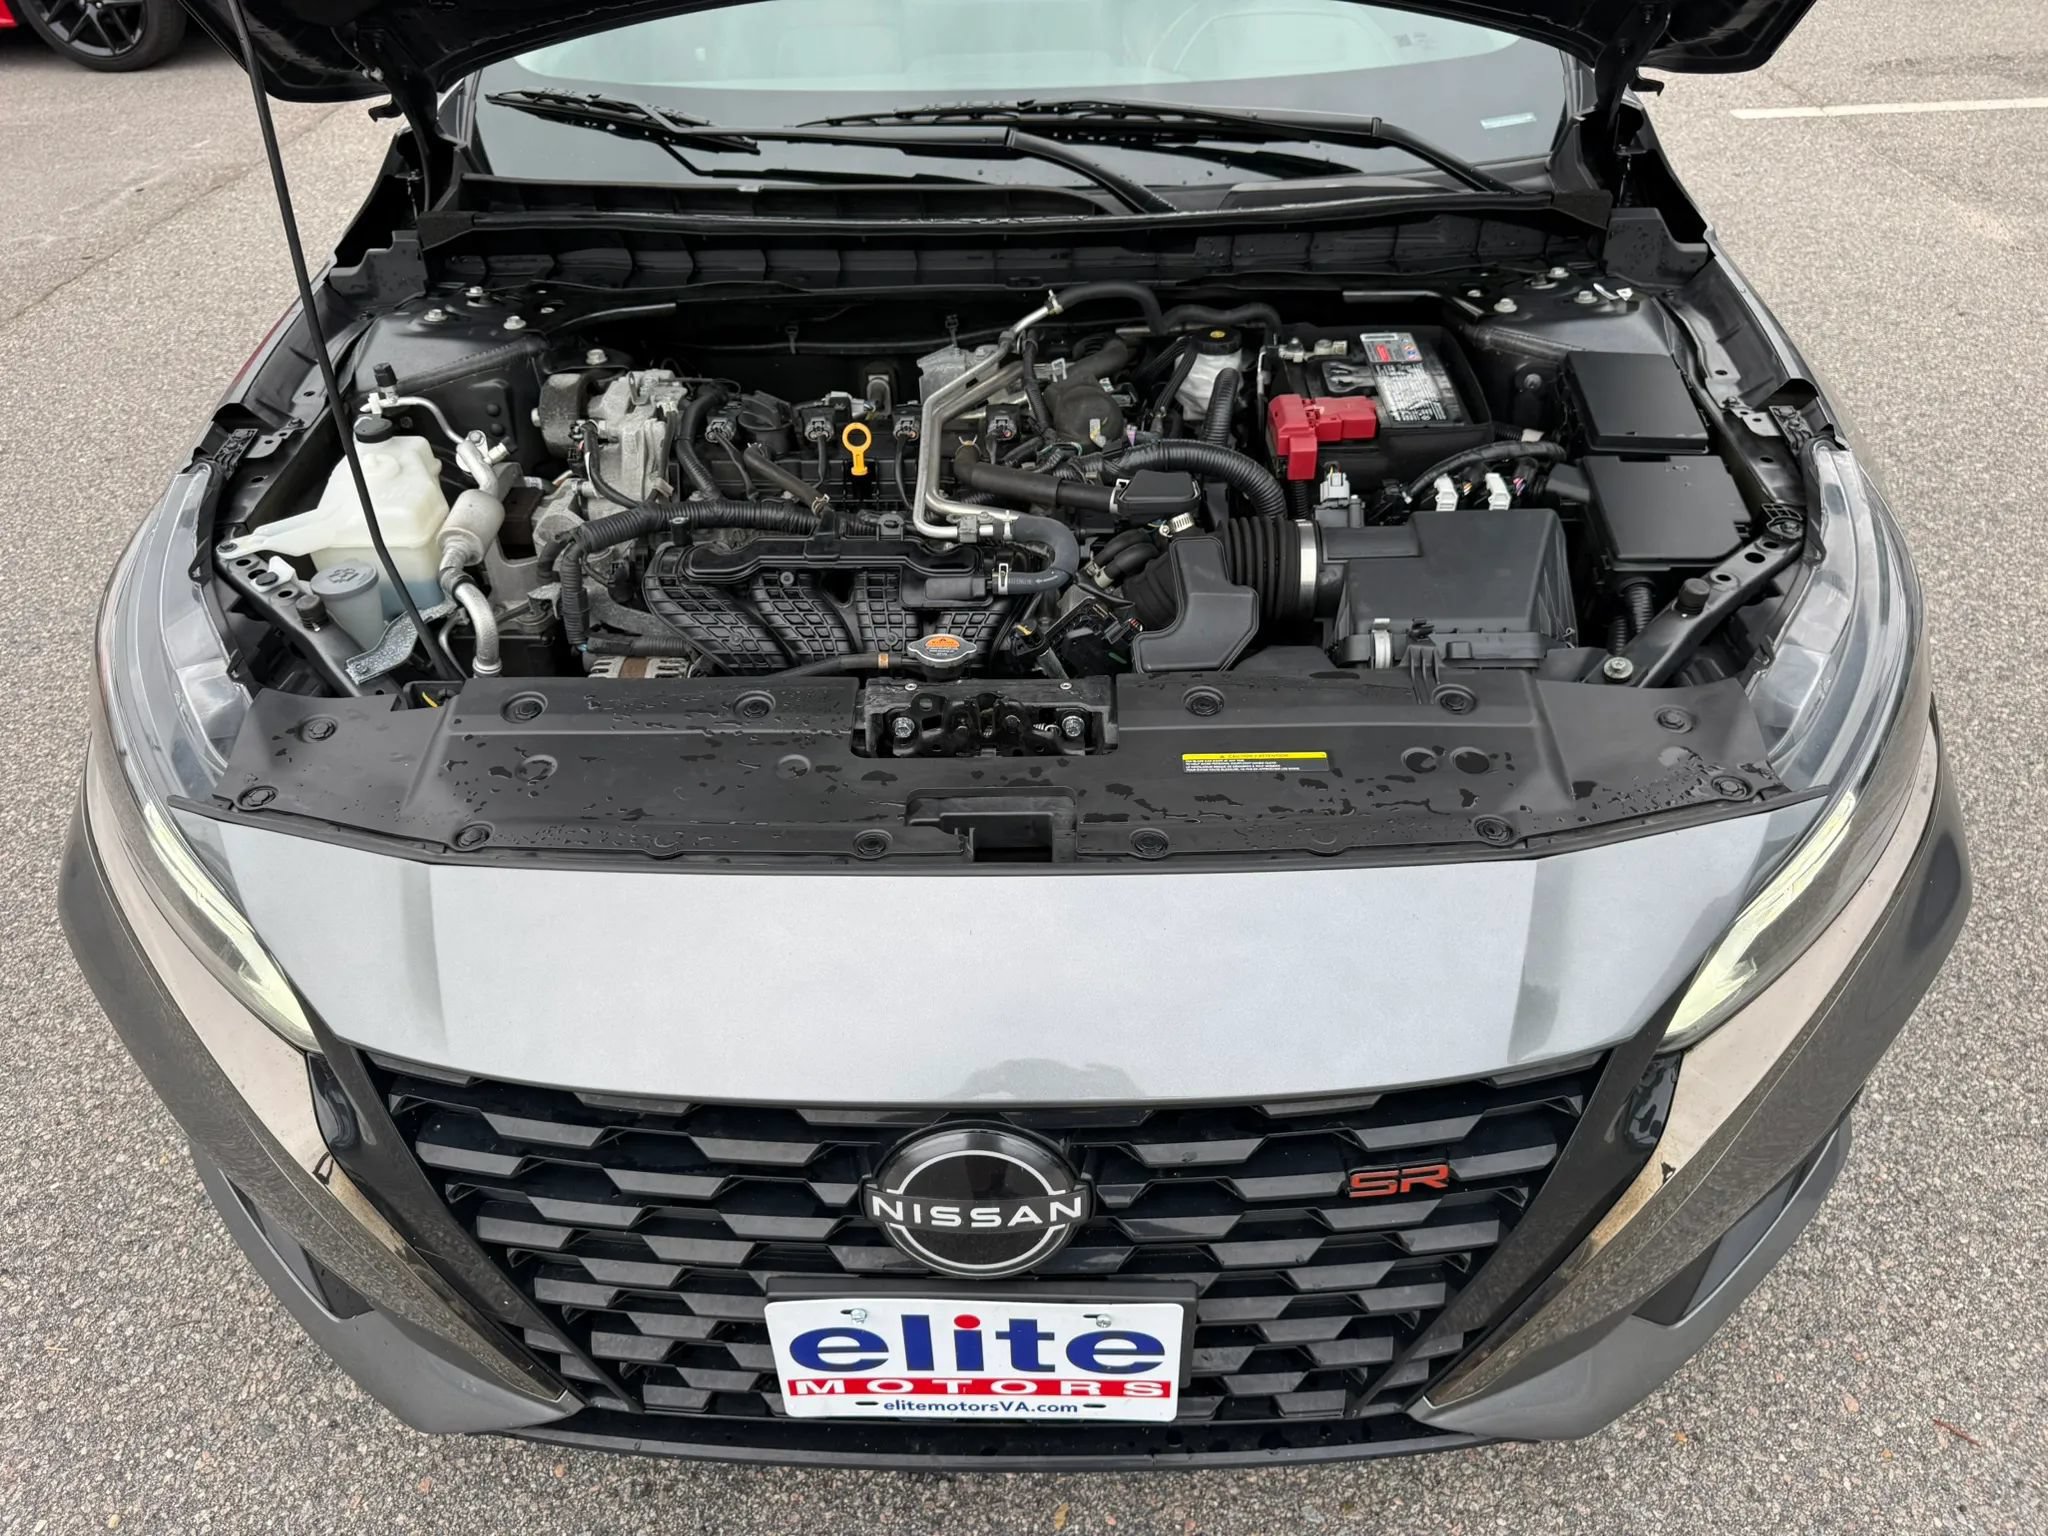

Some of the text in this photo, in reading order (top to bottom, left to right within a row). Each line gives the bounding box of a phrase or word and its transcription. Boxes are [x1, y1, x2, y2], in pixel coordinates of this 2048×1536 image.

[1349, 1164, 1449, 1198] SR
[872, 1195, 1082, 1228] NISSAN
[789, 1313, 1166, 1374] elite
[795, 1378, 1166, 1398] MOTORS
[883, 1399, 1079, 1414] elitemotorsVA.com
